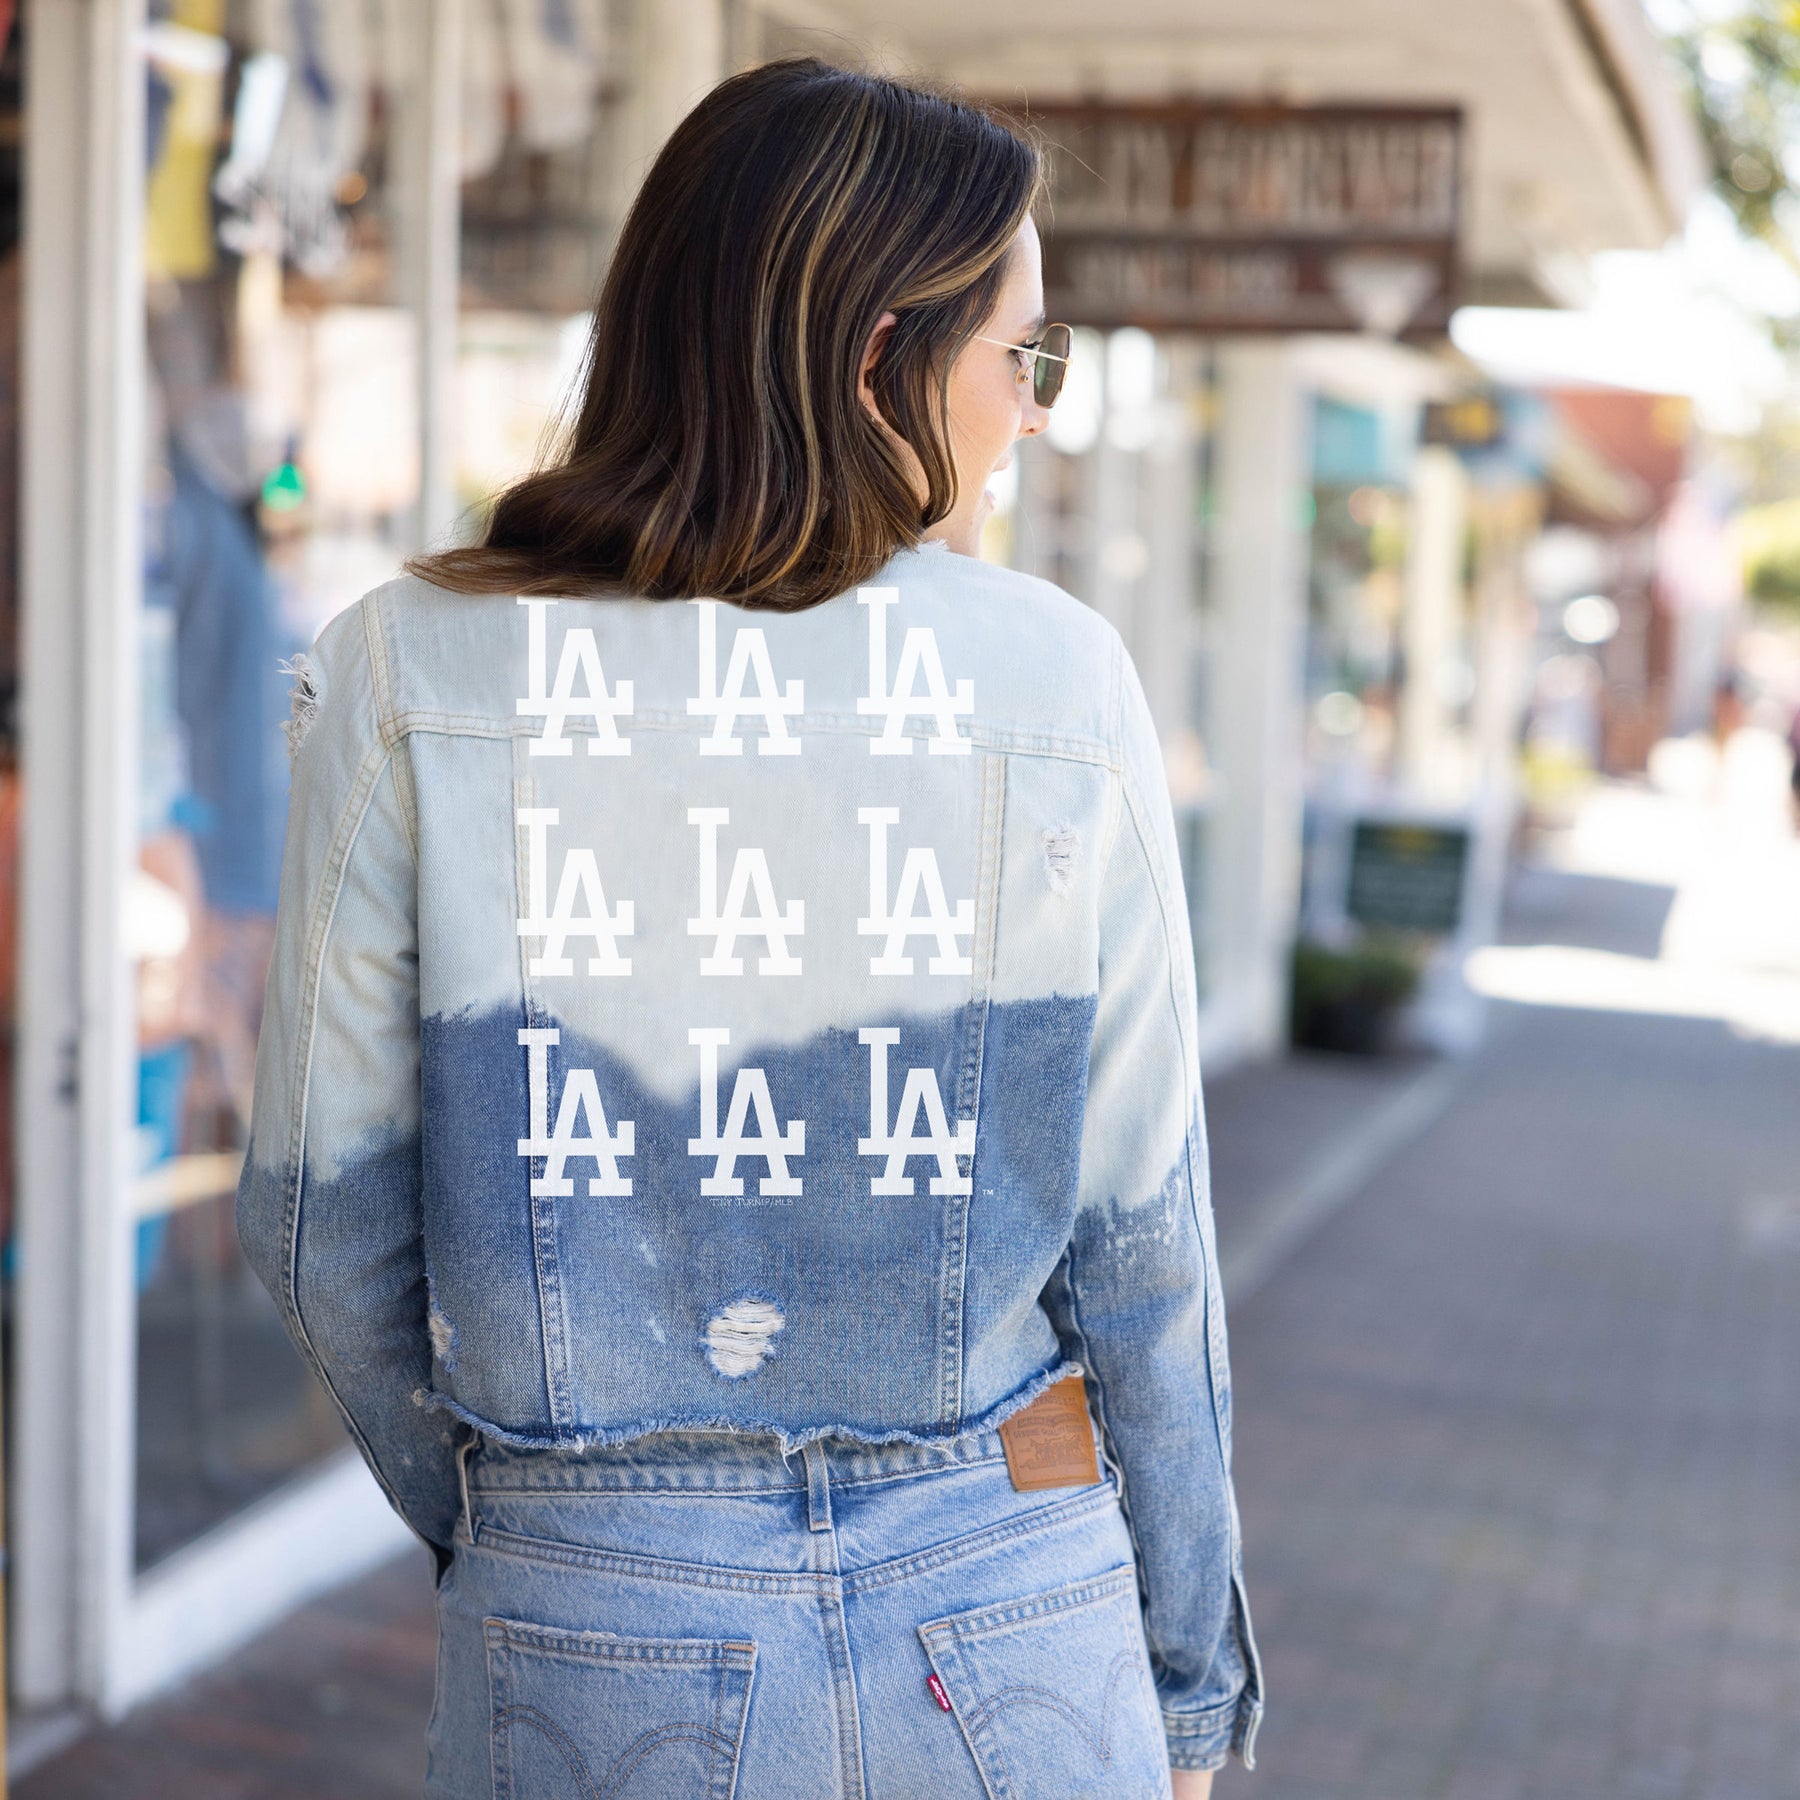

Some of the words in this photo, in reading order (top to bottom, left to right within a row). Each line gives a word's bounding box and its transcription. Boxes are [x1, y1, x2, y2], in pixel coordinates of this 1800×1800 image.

[517, 597, 633, 756] LA
[687, 598, 804, 756] LA
[857, 587, 974, 755] LA
[517, 808, 634, 976] LA
[687, 807, 805, 976] LA
[857, 807, 975, 976] LA
[518, 1028, 635, 1197] LA
[688, 1027, 805, 1196] LA
[858, 1027, 976, 1195] LA
